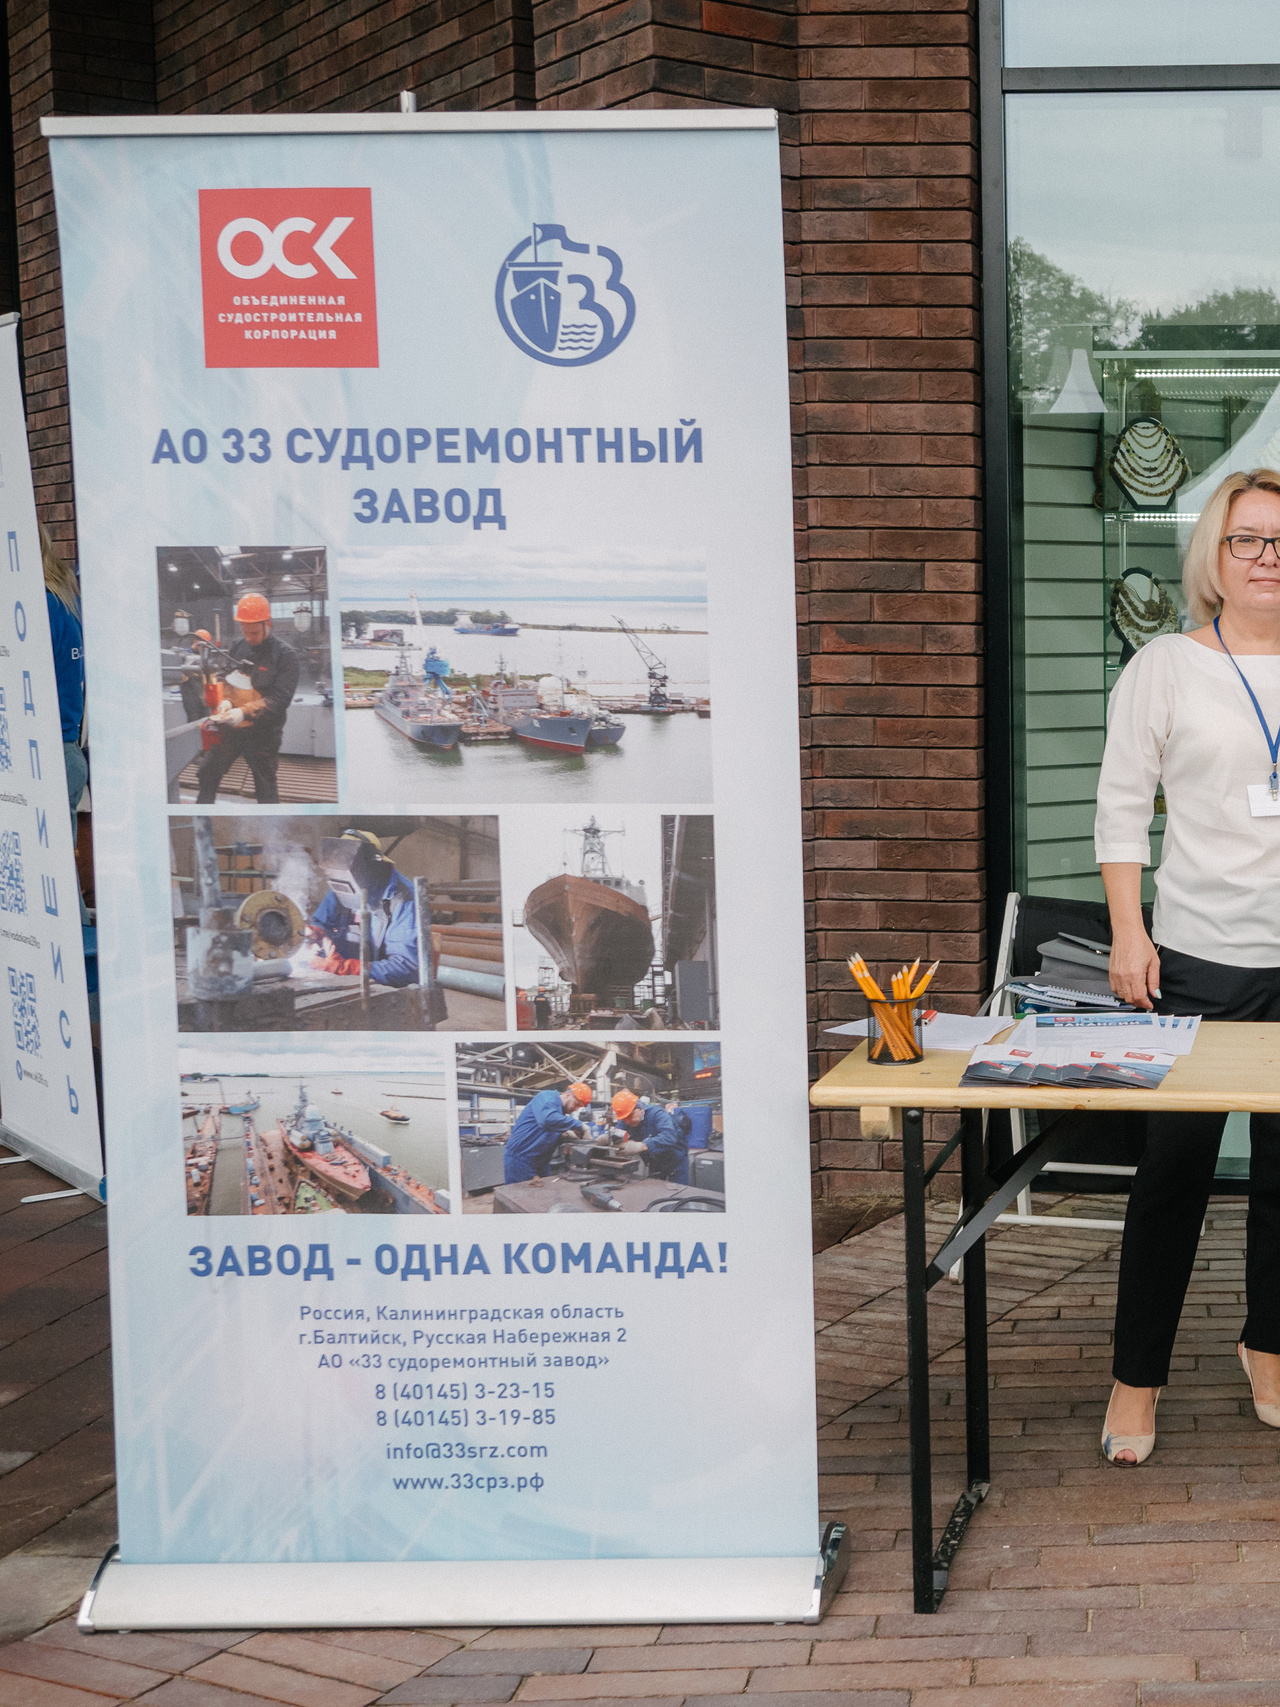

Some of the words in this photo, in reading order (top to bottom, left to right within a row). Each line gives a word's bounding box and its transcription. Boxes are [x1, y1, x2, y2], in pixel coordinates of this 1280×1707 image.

[216, 216, 359, 280] ОСК
[232, 295, 346, 307] ОБЪЕДИНЕННАЯ
[217, 312, 363, 324] СУДОСТРОИТЕЛЬНАЯ
[243, 329, 337, 341] КОРПОРАЦИЯ
[151, 427, 208, 464] АО
[222, 427, 272, 464] 33
[285, 418, 704, 471] СУДОРЕМОНТНЫЙ
[352, 487, 508, 531] ЗАВОД
[188, 1244, 334, 1282] ЗАВОД
[374, 1243, 492, 1282] ОДНА
[503, 1241, 728, 1279] КОМАНДА!
[299, 1305, 371, 1322] Россия,
[376, 1305, 545, 1323] Калининградская
[550, 1303, 625, 1319] область
[298, 1329, 407, 1347] г.Балтийск,
[412, 1329, 487, 1348] Русская
[492, 1328, 611, 1348] Набережная
[616, 1327, 627, 1343] 2
[317, 1353, 343, 1369] АО
[349, 1353, 383, 1369] «33
[387, 1352, 537, 1371] судоремонтный
[542, 1354, 610, 1370] завод»
[375, 1383, 387, 1401] 8
[392, 1381, 468, 1402] (40145)
[474, 1381, 555, 1400] 3-23-15
[376, 1409, 388, 1427] 8
[394, 1408, 469, 1429] (40145)
[475, 1408, 556, 1426] 3-19-85
[386, 1441, 548, 1460] info@33srz.com
[392, 1471, 545, 1494] www.33срз.рф
